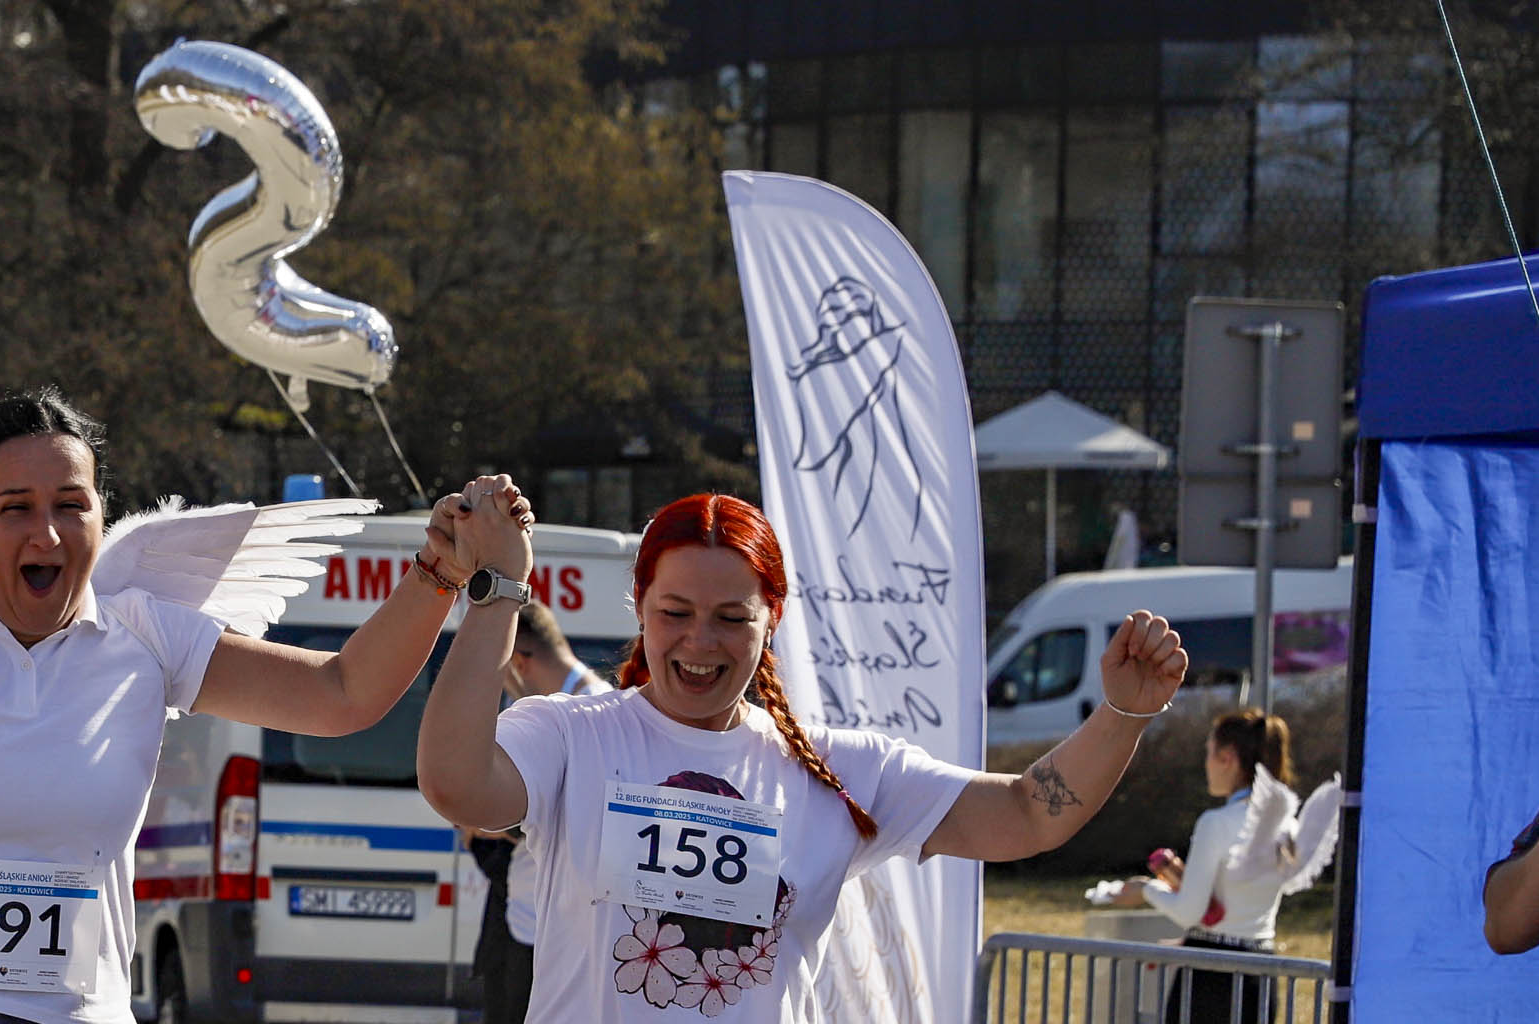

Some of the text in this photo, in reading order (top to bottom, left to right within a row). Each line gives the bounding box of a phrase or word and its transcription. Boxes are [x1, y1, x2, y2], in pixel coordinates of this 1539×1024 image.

[134, 38, 398, 388] 2
[325, 556, 584, 611] AMNS
[625, 793, 643, 804] BIEG
[642, 795, 678, 807] FUNDACJI
[706, 805, 732, 816] ANIOŁY
[696, 815, 734, 828] KATOWICE
[637, 823, 748, 885] 158
[27, 873, 53, 883] ANIOŁY
[17, 886, 54, 896] KATOWICE
